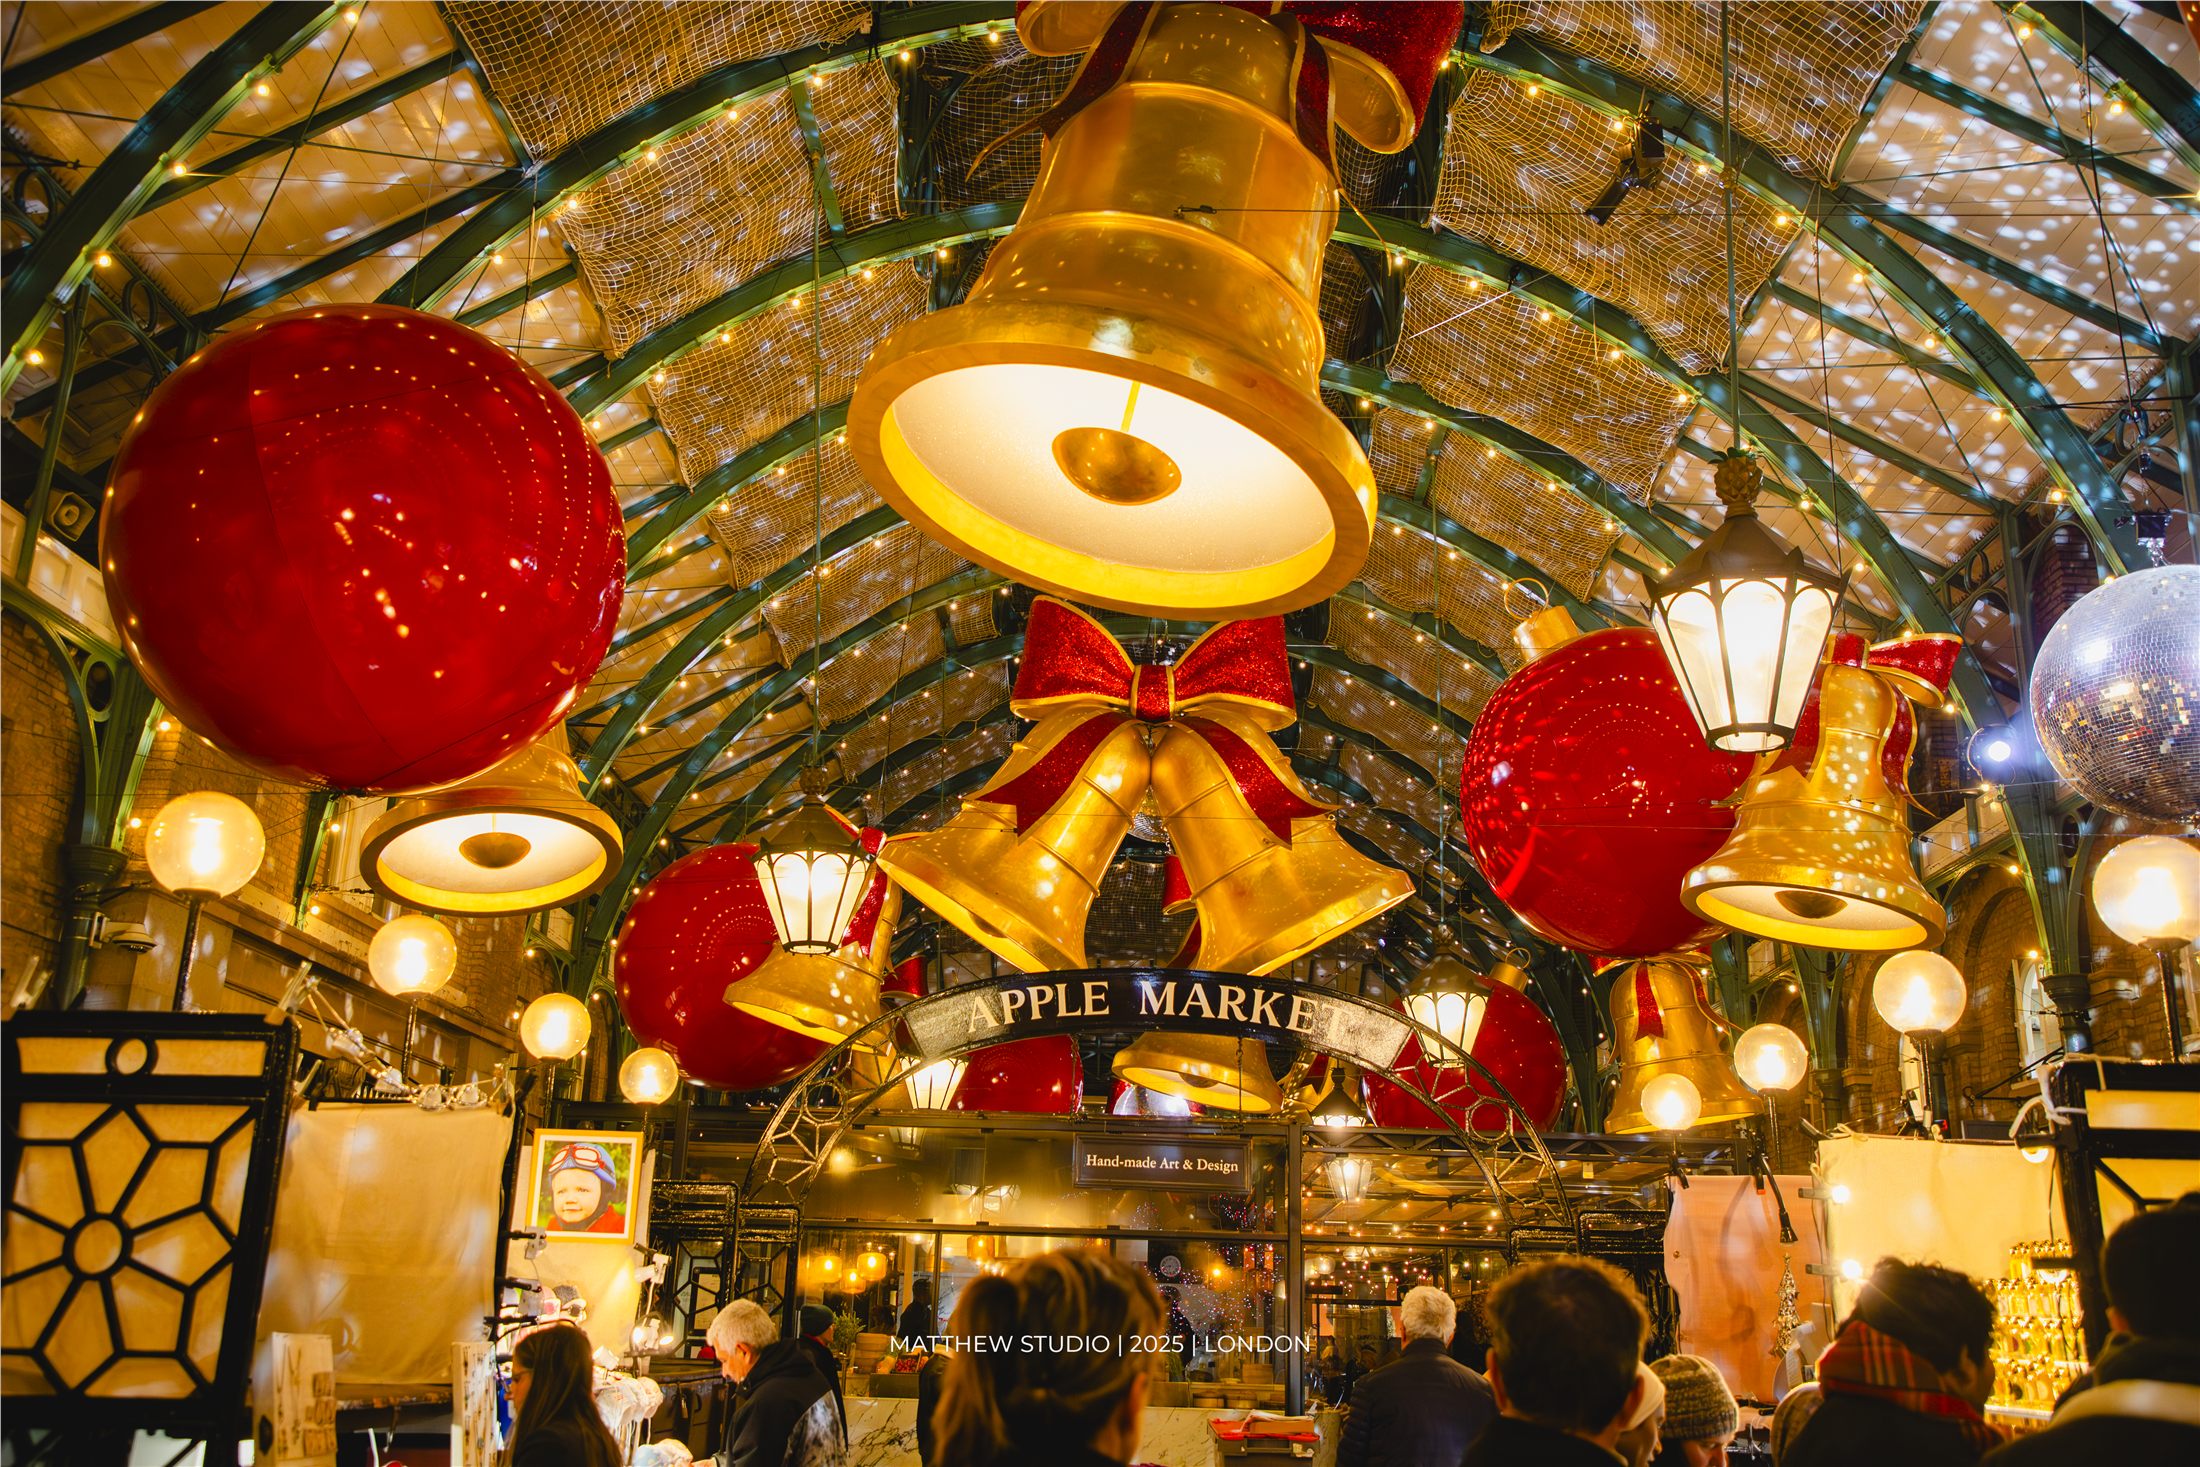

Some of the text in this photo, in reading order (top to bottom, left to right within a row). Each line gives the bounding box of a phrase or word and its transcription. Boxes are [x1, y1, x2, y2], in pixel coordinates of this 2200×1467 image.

[968, 980, 1354, 1041] APPLE MARKET
[1086, 1154, 1239, 1174] Hand-made Art & Design
